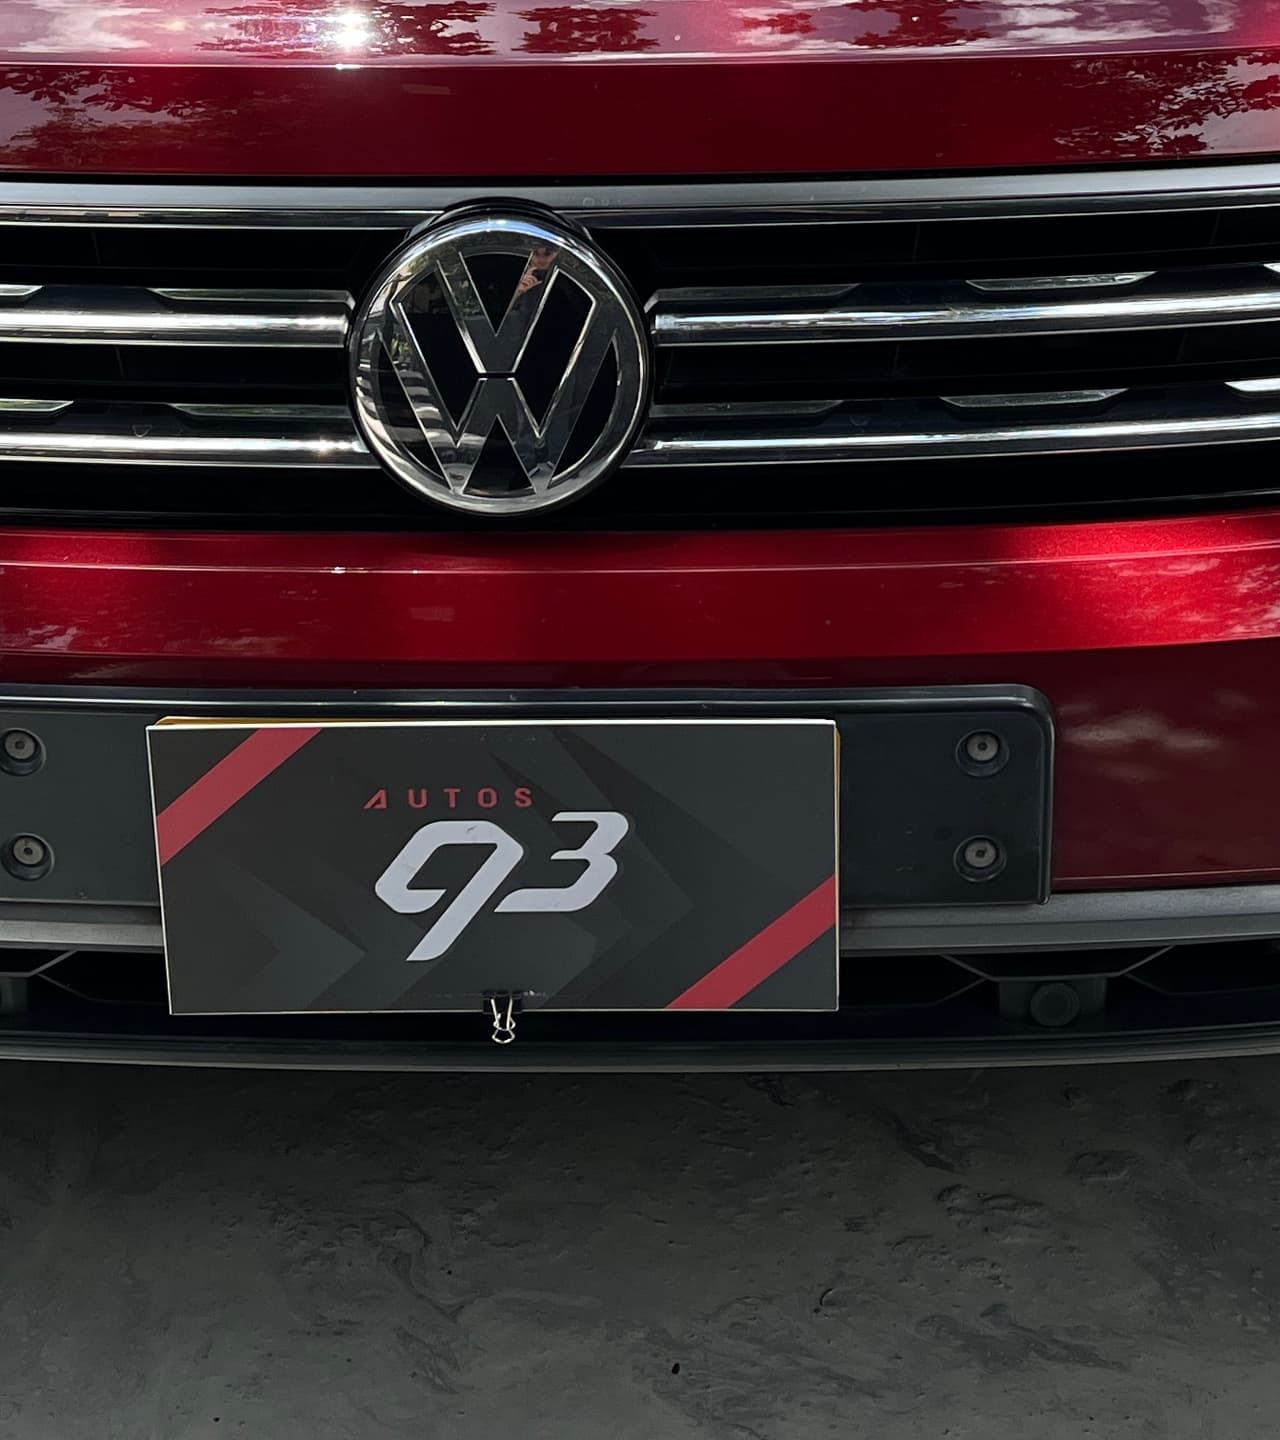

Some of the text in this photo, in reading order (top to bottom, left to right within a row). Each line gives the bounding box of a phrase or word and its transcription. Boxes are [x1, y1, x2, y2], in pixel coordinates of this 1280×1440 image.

[370, 240, 625, 498] VW
[363, 786, 534, 810] AUTOS
[374, 810, 630, 962] 93
